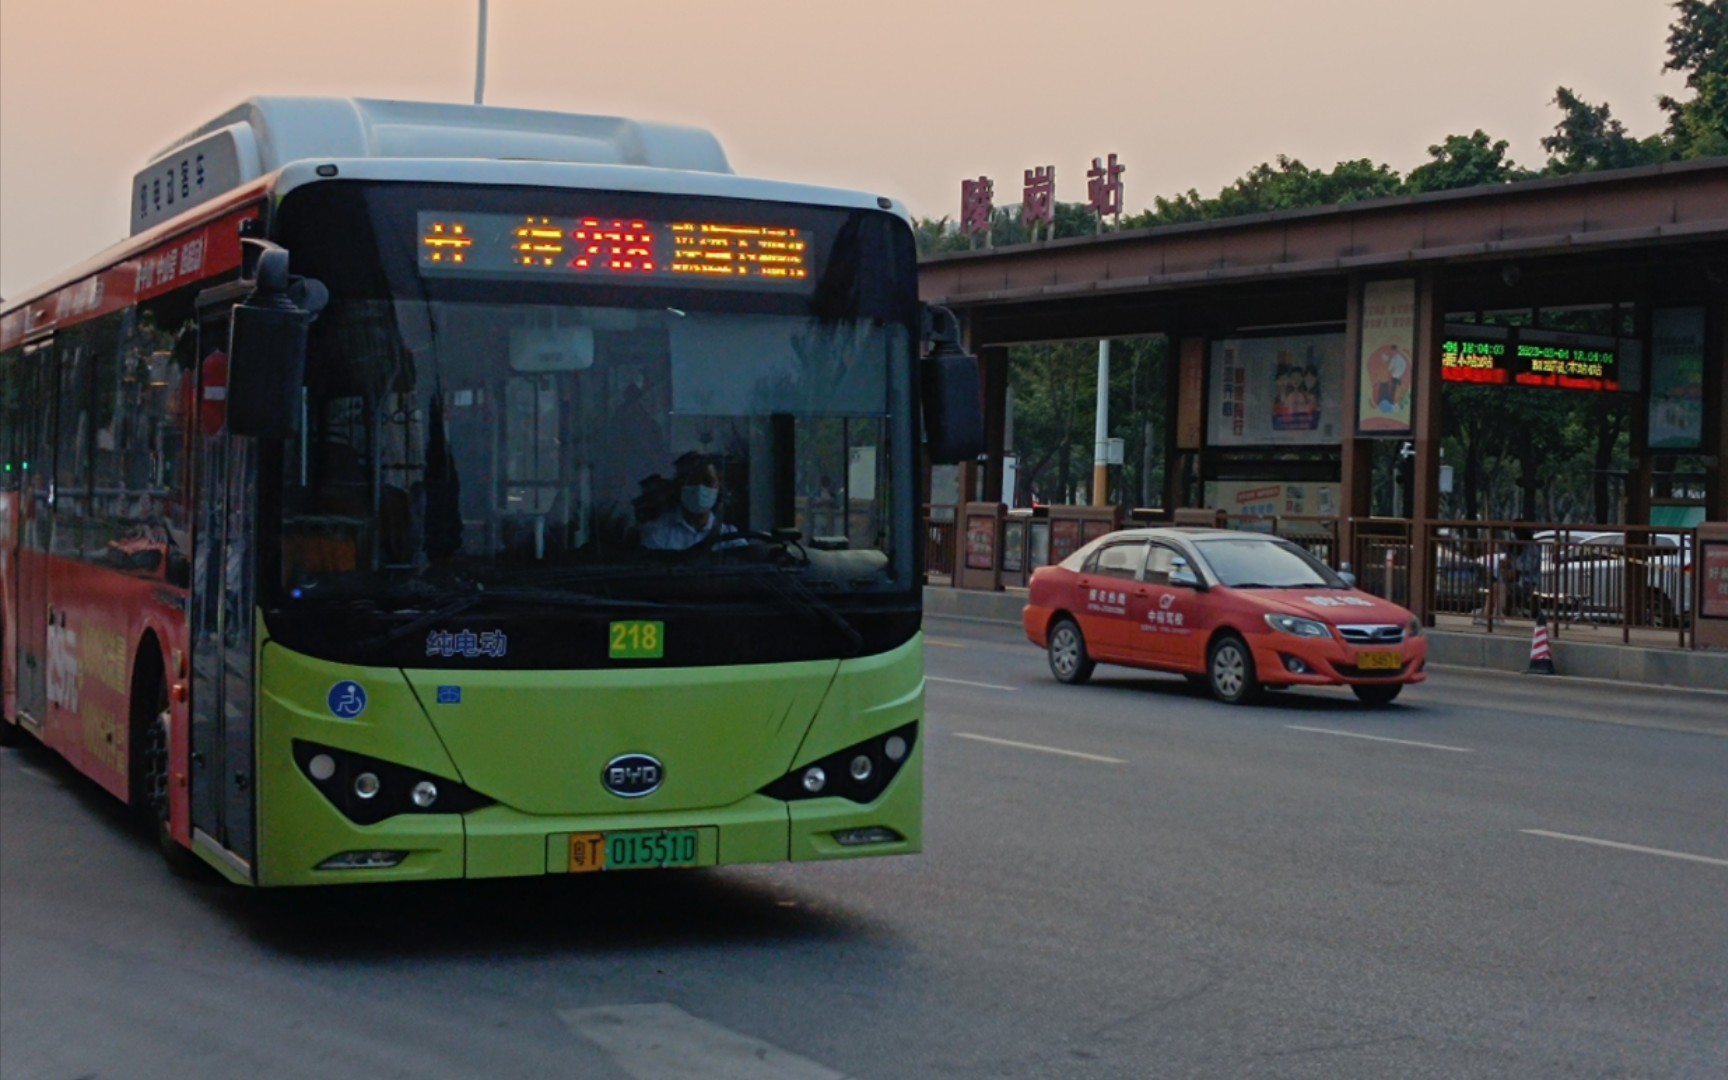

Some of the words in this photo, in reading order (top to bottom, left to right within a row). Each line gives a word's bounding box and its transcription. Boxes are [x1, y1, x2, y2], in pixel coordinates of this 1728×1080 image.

[426, 629, 507, 657] 纯电动
[612, 623, 656, 650] 218
[609, 766, 657, 785] BYD
